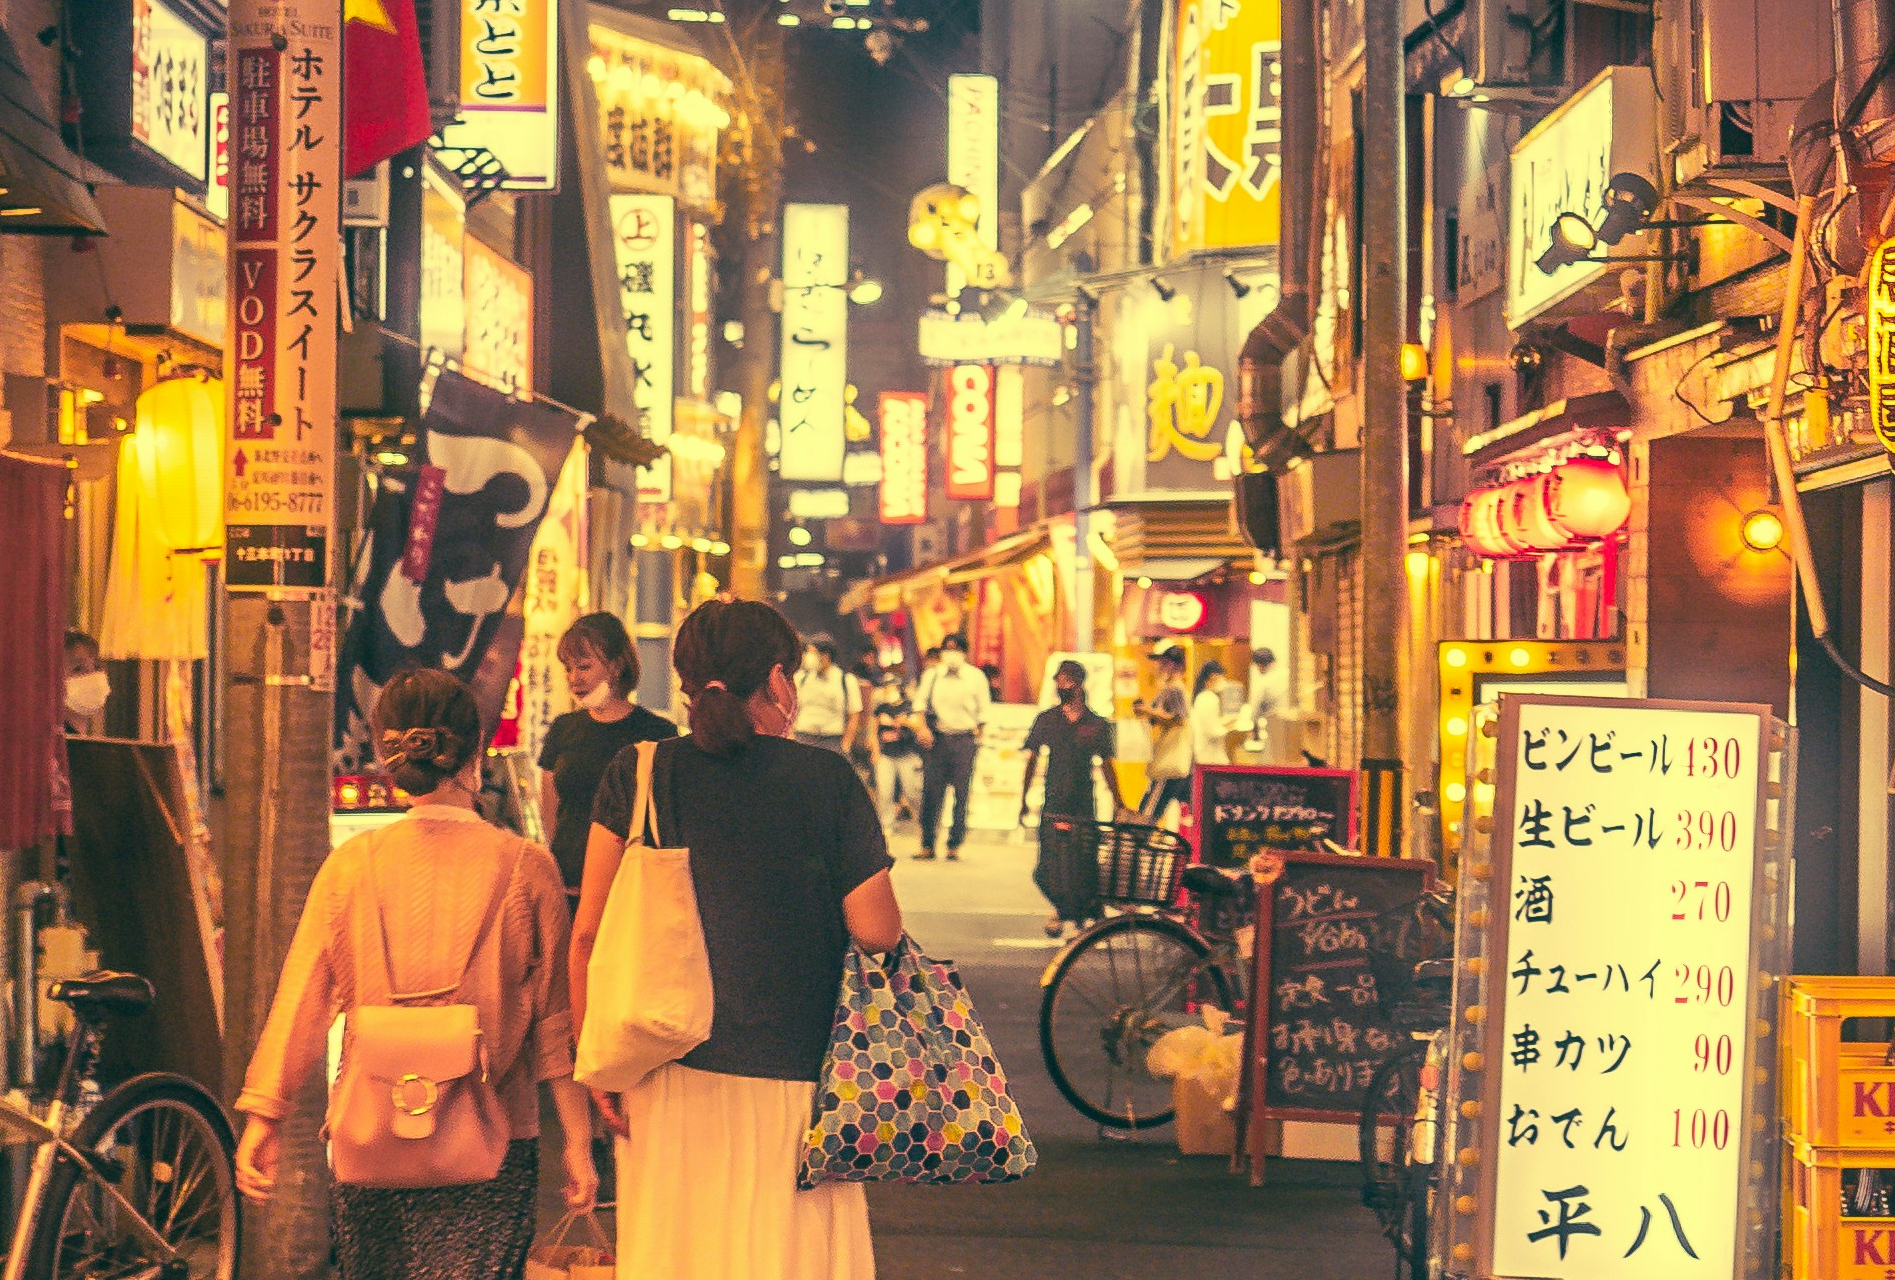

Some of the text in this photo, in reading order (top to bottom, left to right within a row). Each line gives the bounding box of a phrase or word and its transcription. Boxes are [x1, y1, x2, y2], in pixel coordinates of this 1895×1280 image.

[287, 48, 324, 152] ホテル
[239, 53, 277, 231] 駐車場無料
[1522, 728, 1673, 776] ビンビール
[1517, 799, 1737, 853] 生ビール 390
[1514, 875, 1732, 924] 酒 270
[1511, 949, 1735, 1008] チューハイ 290
[1510, 1024, 1733, 1076] 串カツ 90
[1507, 1104, 1730, 1152] おでん 100
[1526, 1184, 1701, 1261] 平八
